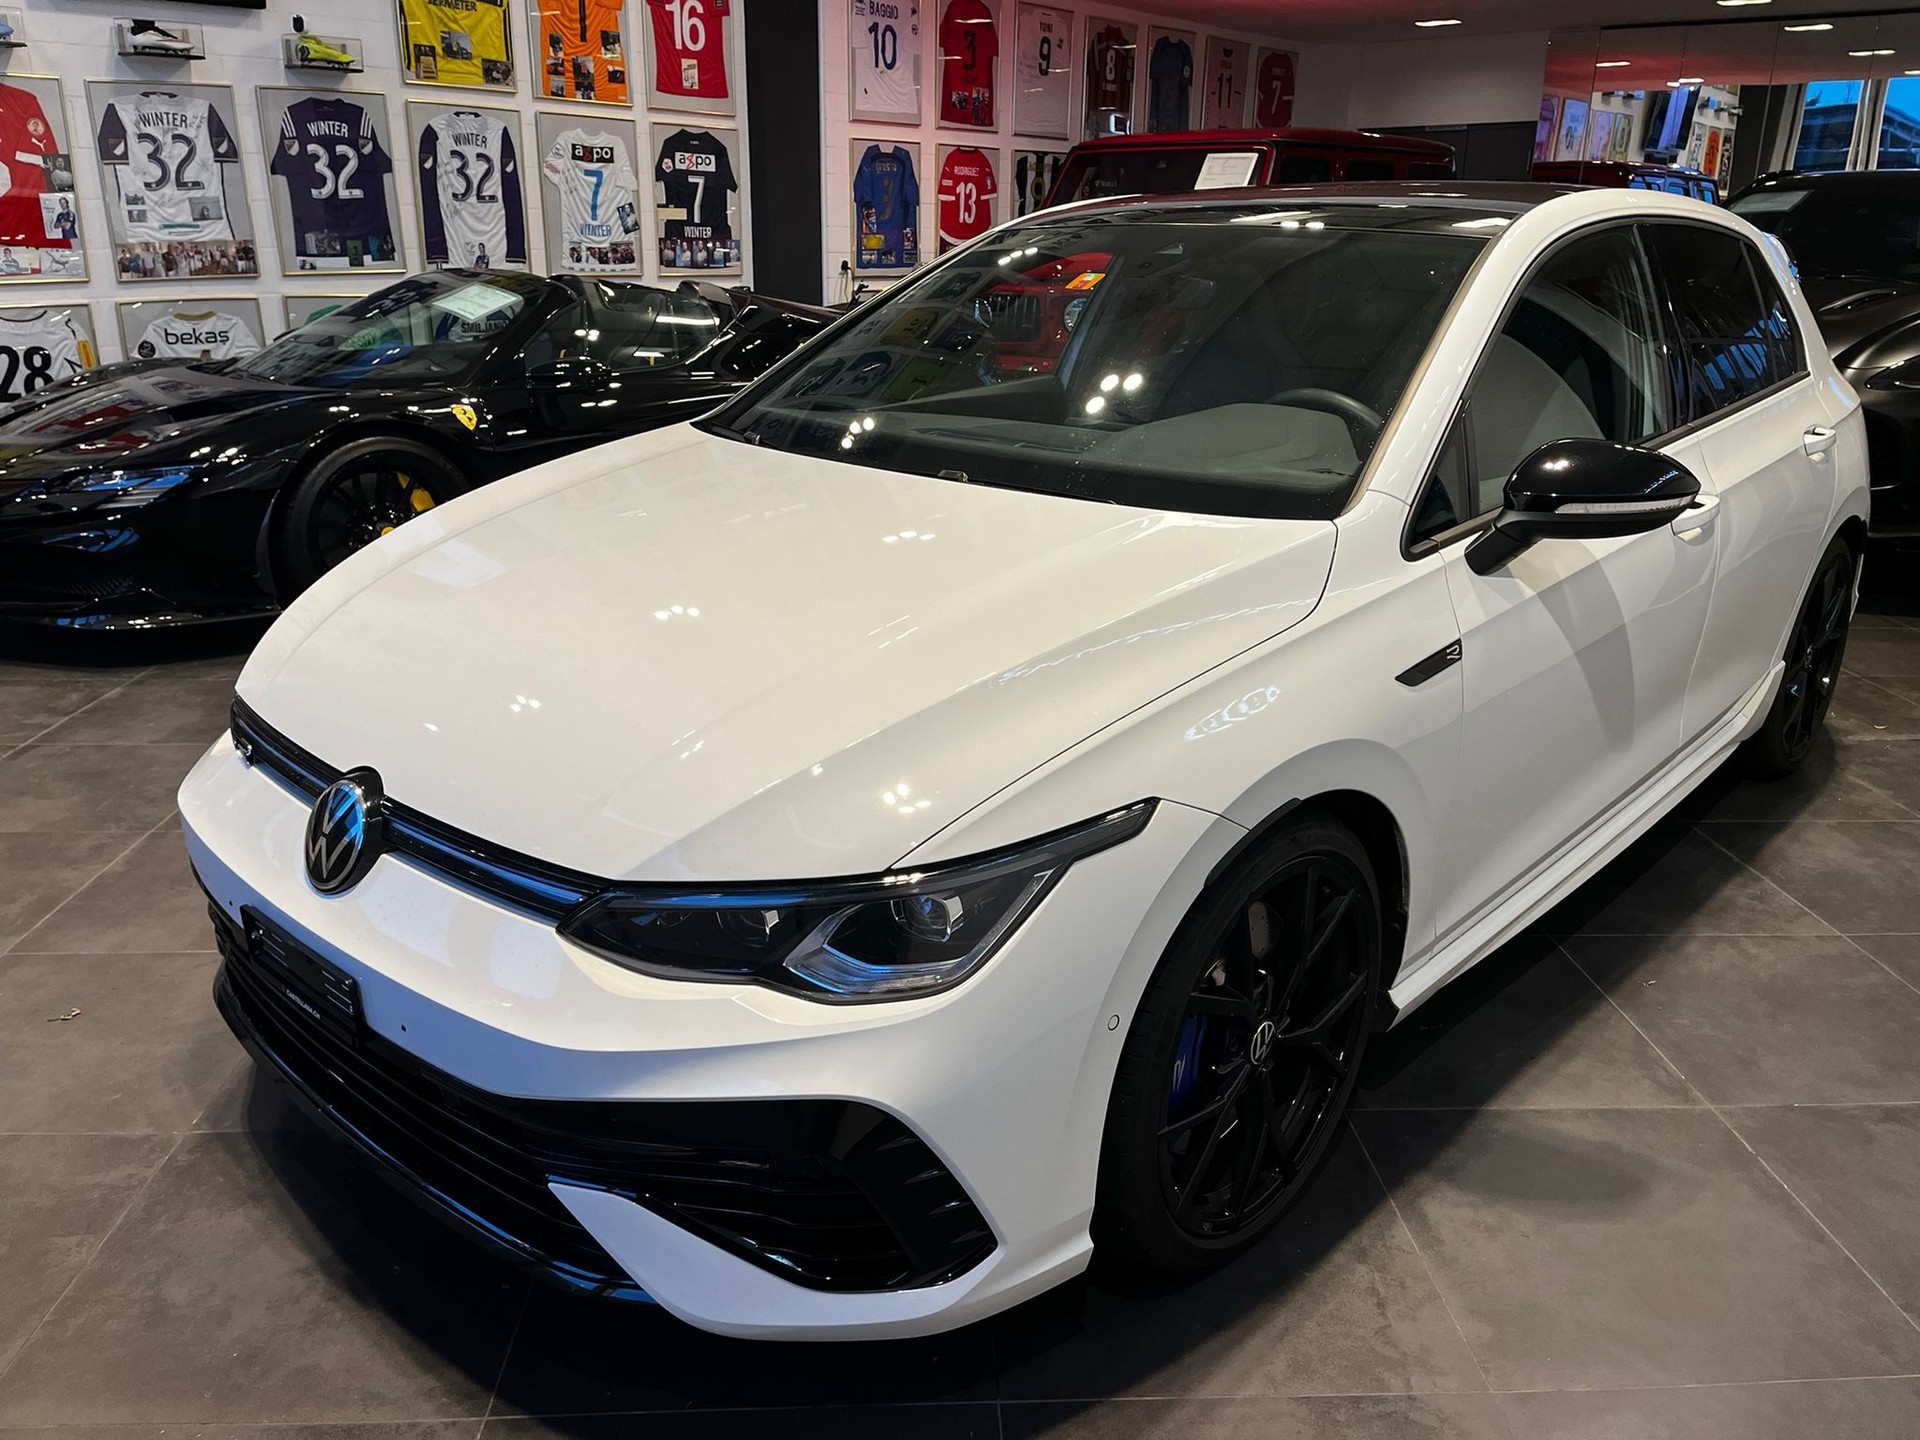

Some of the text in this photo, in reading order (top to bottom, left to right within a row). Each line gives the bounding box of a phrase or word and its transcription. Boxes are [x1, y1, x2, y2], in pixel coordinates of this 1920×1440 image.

[665, 0, 706, 52] 16
[869, 0, 899, 19] BAGGIO
[868, 21, 898, 70] 10
[1038, 36, 1051, 76] 9
[1105, 48, 1117, 81] 8
[1217, 73, 1234, 109] 11
[1270, 80, 1282, 115] 7
[138, 111, 188, 129] WINTER
[306, 121, 349, 138] WINTER
[451, 132, 488, 149] WINTER
[137, 133, 205, 191] 32
[306, 143, 364, 199] 32
[449, 149, 499, 204] 32
[583, 168, 604, 222] 7
[687, 174, 706, 224] 7
[955, 181, 977, 225] 13
[579, 223, 612, 237] WINTER
[683, 225, 713, 239] WINTER
[0, 345, 55, 403] 28
